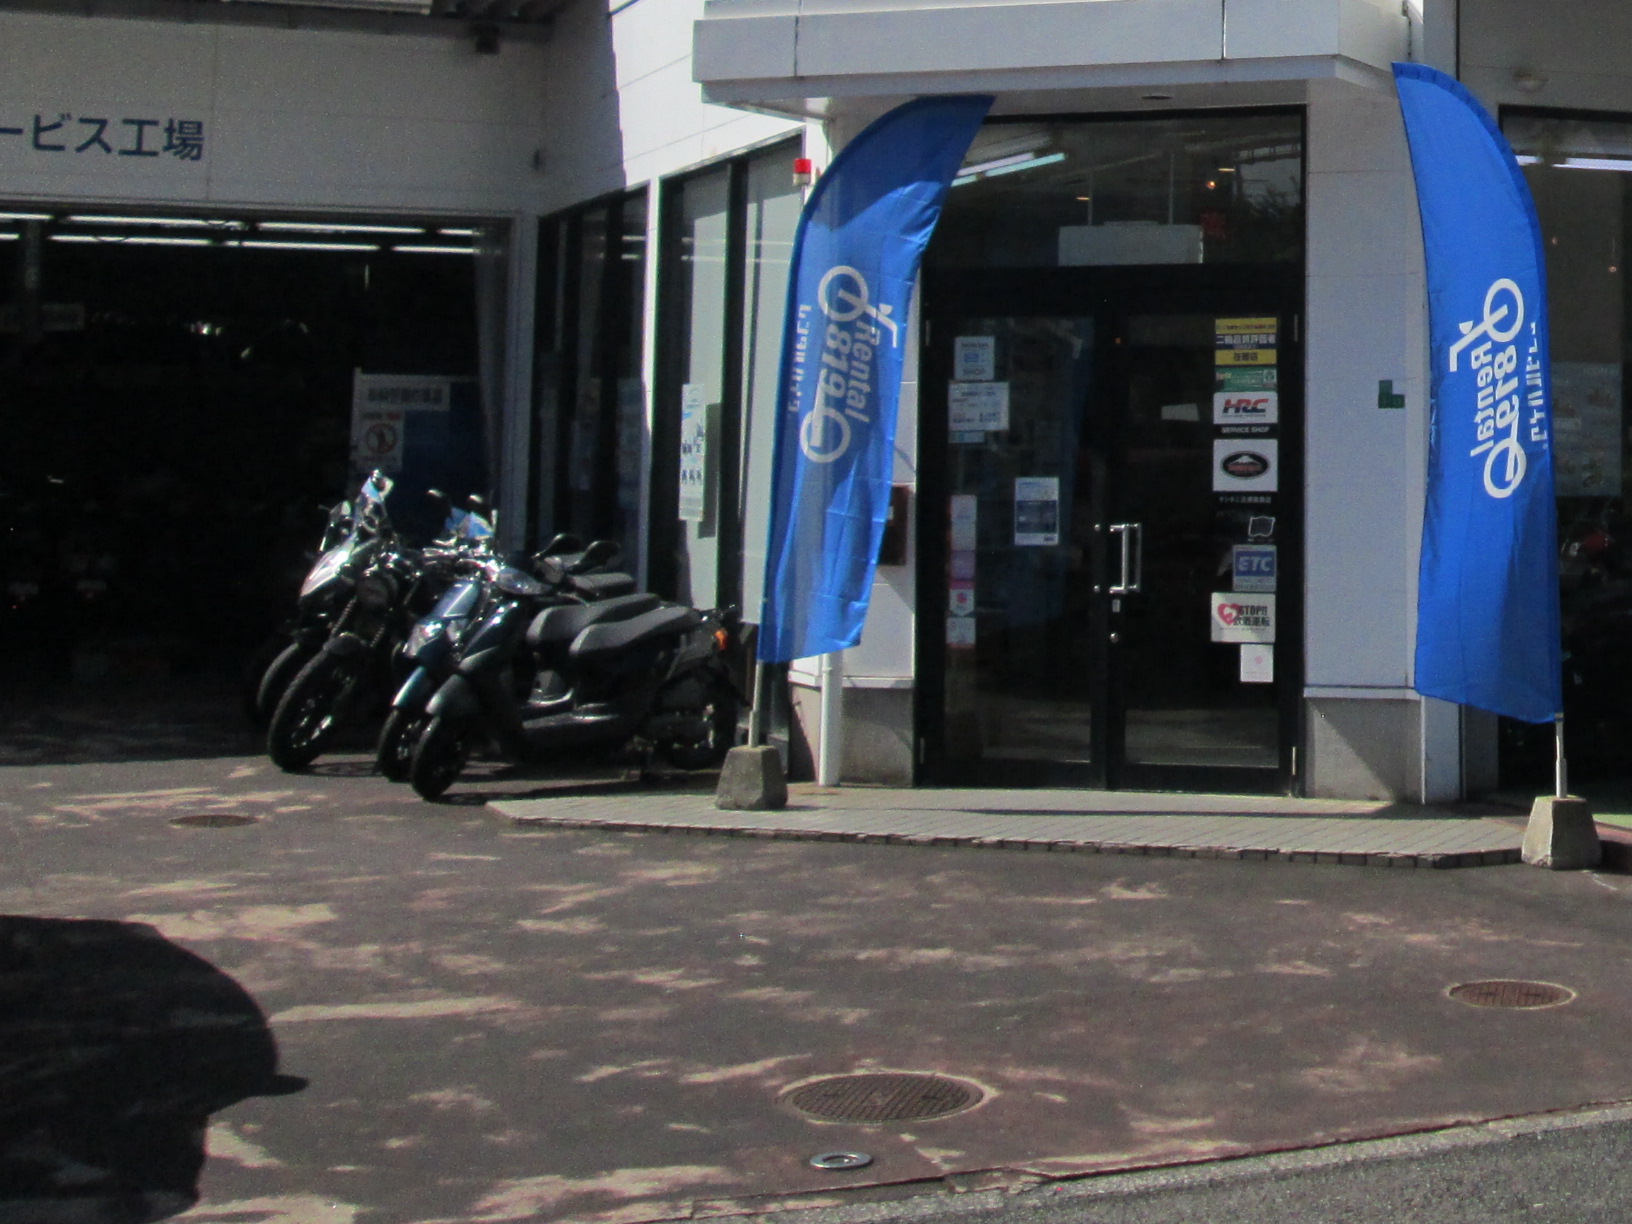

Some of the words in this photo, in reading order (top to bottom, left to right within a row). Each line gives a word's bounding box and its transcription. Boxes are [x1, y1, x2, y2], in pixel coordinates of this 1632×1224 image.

[0, 112, 204, 161] ービス工場
[844, 319, 881, 424] Rental
[1222, 398, 1269, 414] HRC
[1238, 556, 1273, 572] ETC
